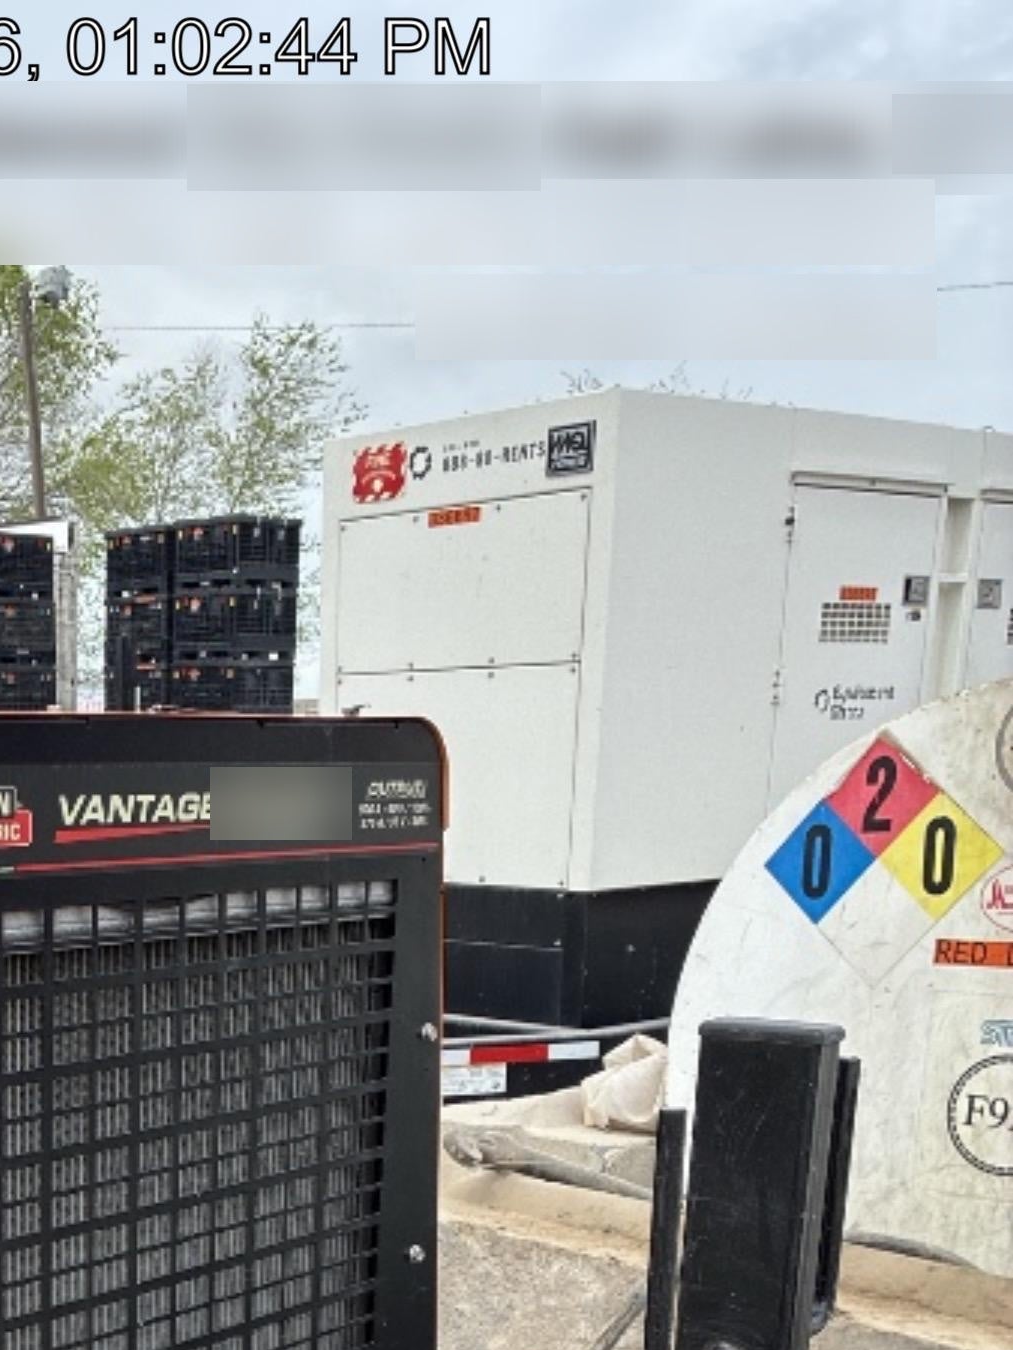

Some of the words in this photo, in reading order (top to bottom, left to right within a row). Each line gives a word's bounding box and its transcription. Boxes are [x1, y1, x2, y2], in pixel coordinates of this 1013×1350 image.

[861, 754, 898, 833] 2
[935, 939, 988, 965] RED
[962, 1094, 1013, 1131] F9
